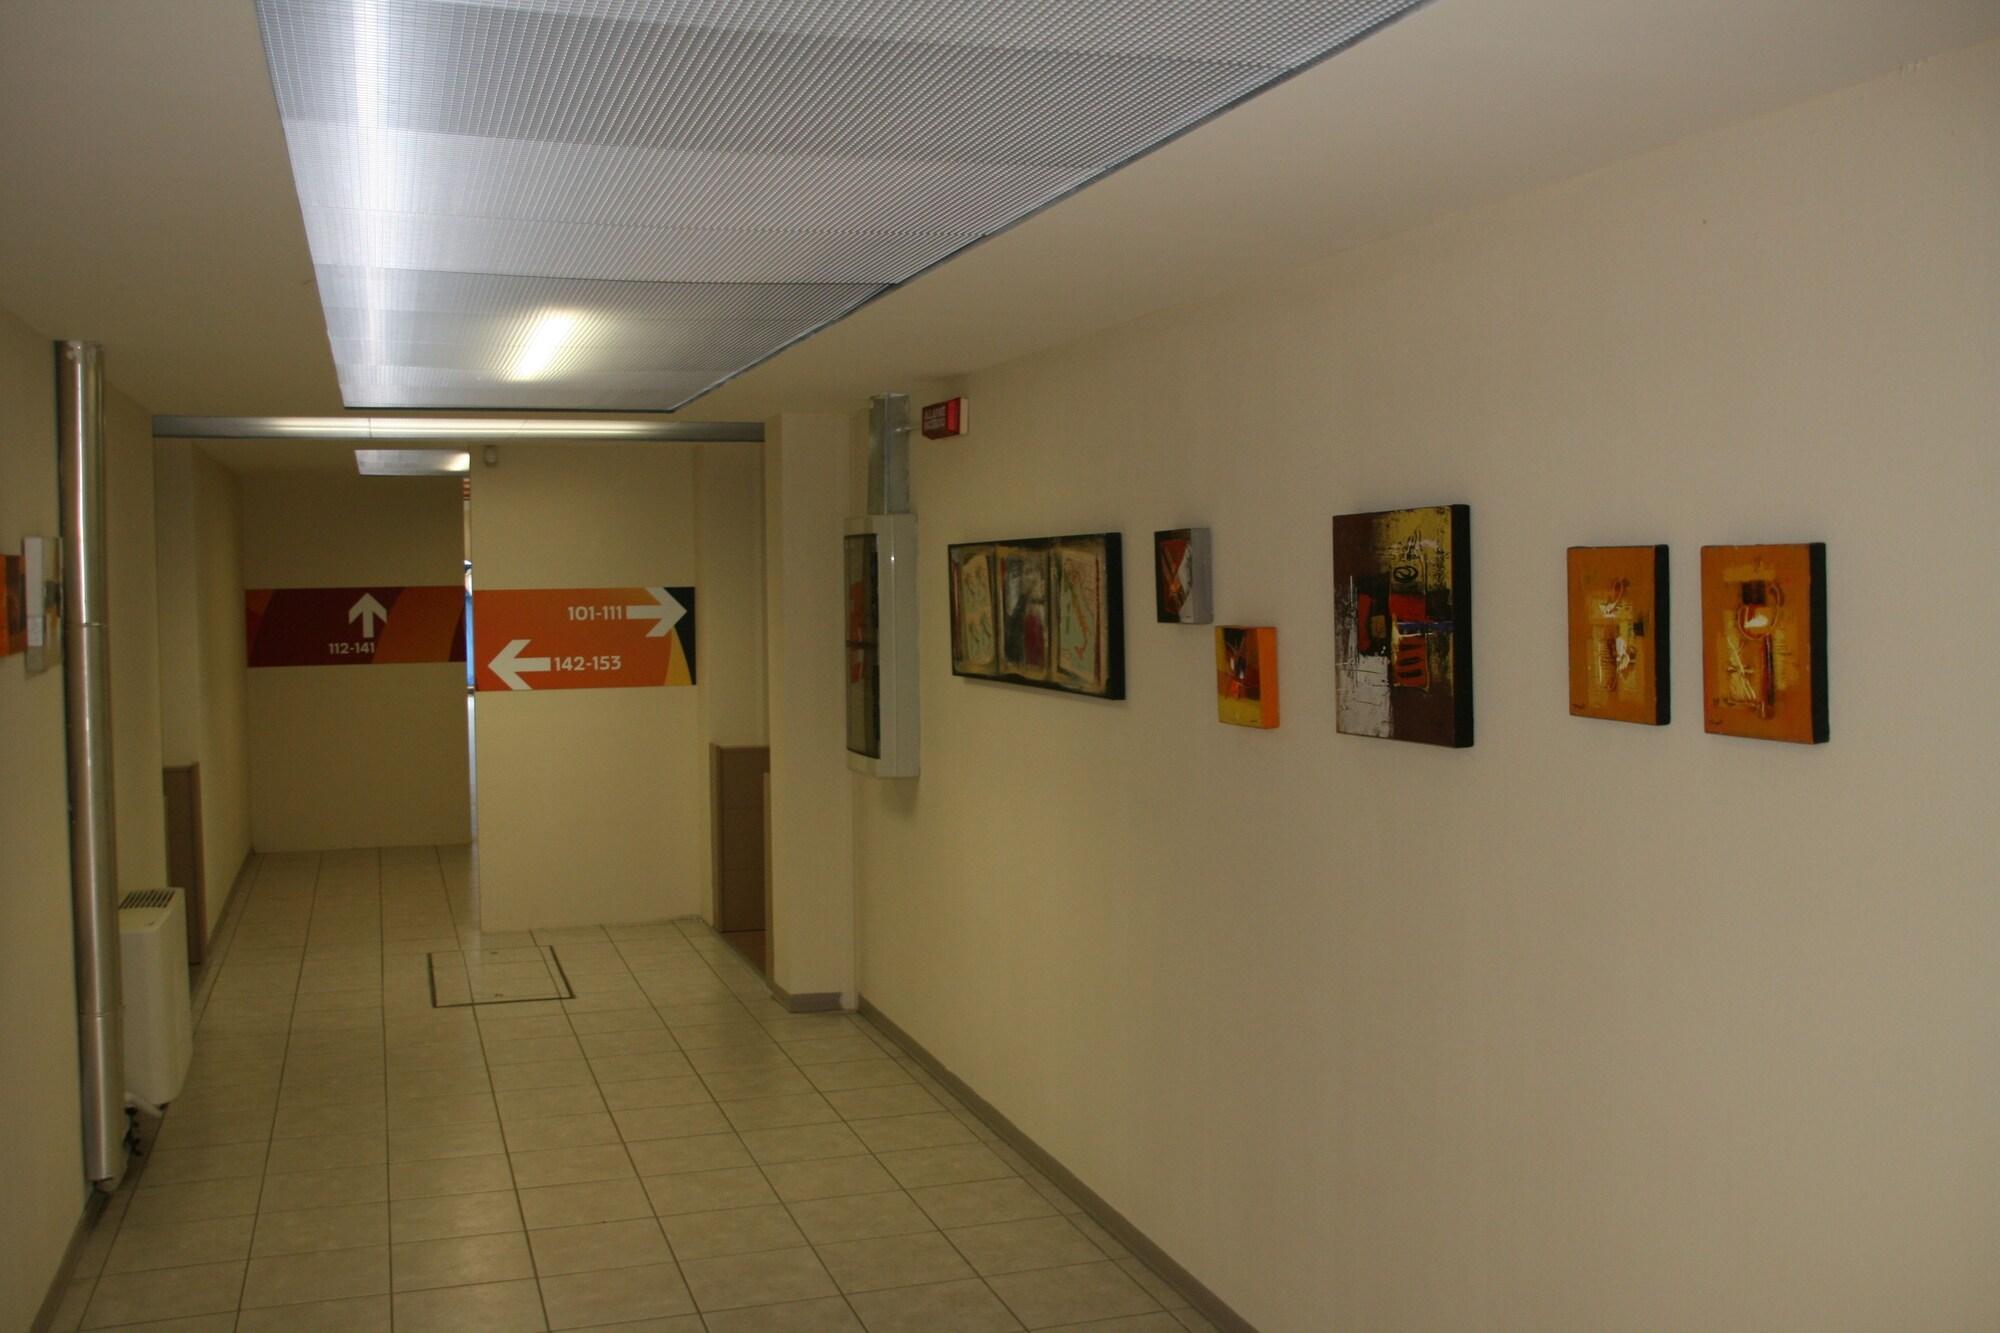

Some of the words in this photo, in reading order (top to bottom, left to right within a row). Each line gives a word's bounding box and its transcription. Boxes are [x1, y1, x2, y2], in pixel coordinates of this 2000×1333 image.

[567, 605, 622, 621] 101-111
[328, 642, 375, 655] 112-141
[554, 655, 622, 672] 142-153
